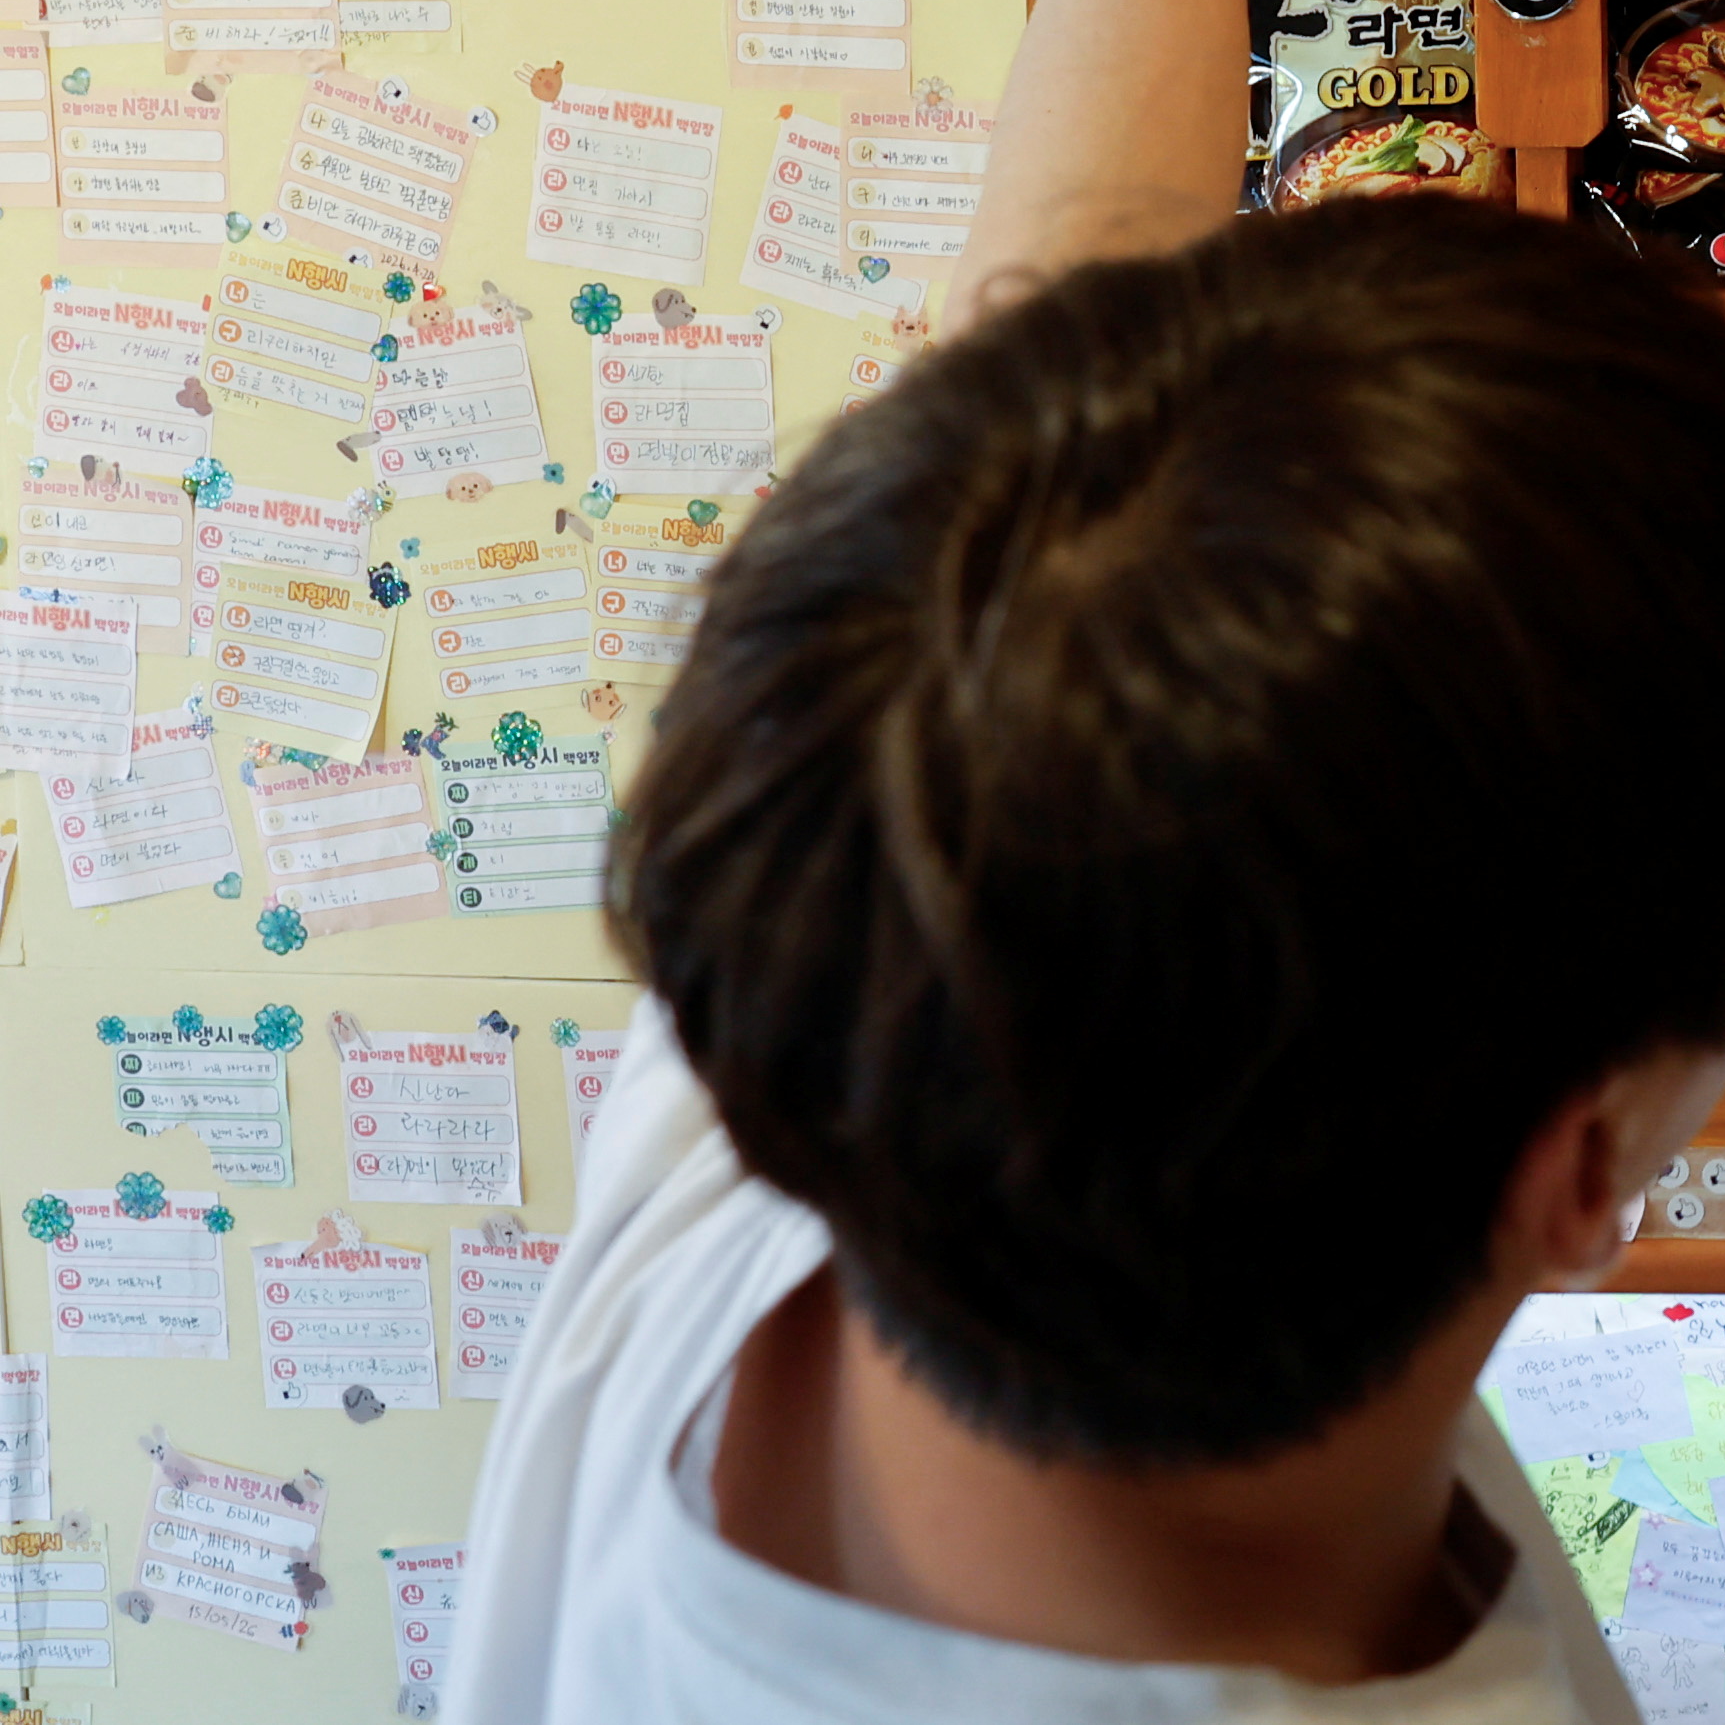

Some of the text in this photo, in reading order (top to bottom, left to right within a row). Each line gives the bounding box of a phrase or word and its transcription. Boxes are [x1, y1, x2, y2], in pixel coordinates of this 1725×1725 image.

[1317, 64, 1471, 110] GOLD
[348, 1043, 507, 1067] 오늘이라면 N행시 백일장
[400, 1077, 470, 1102] 신난다
[226, 1506, 271, 1527] БЫЛИ
[193, 1551, 235, 1573] РОМА
